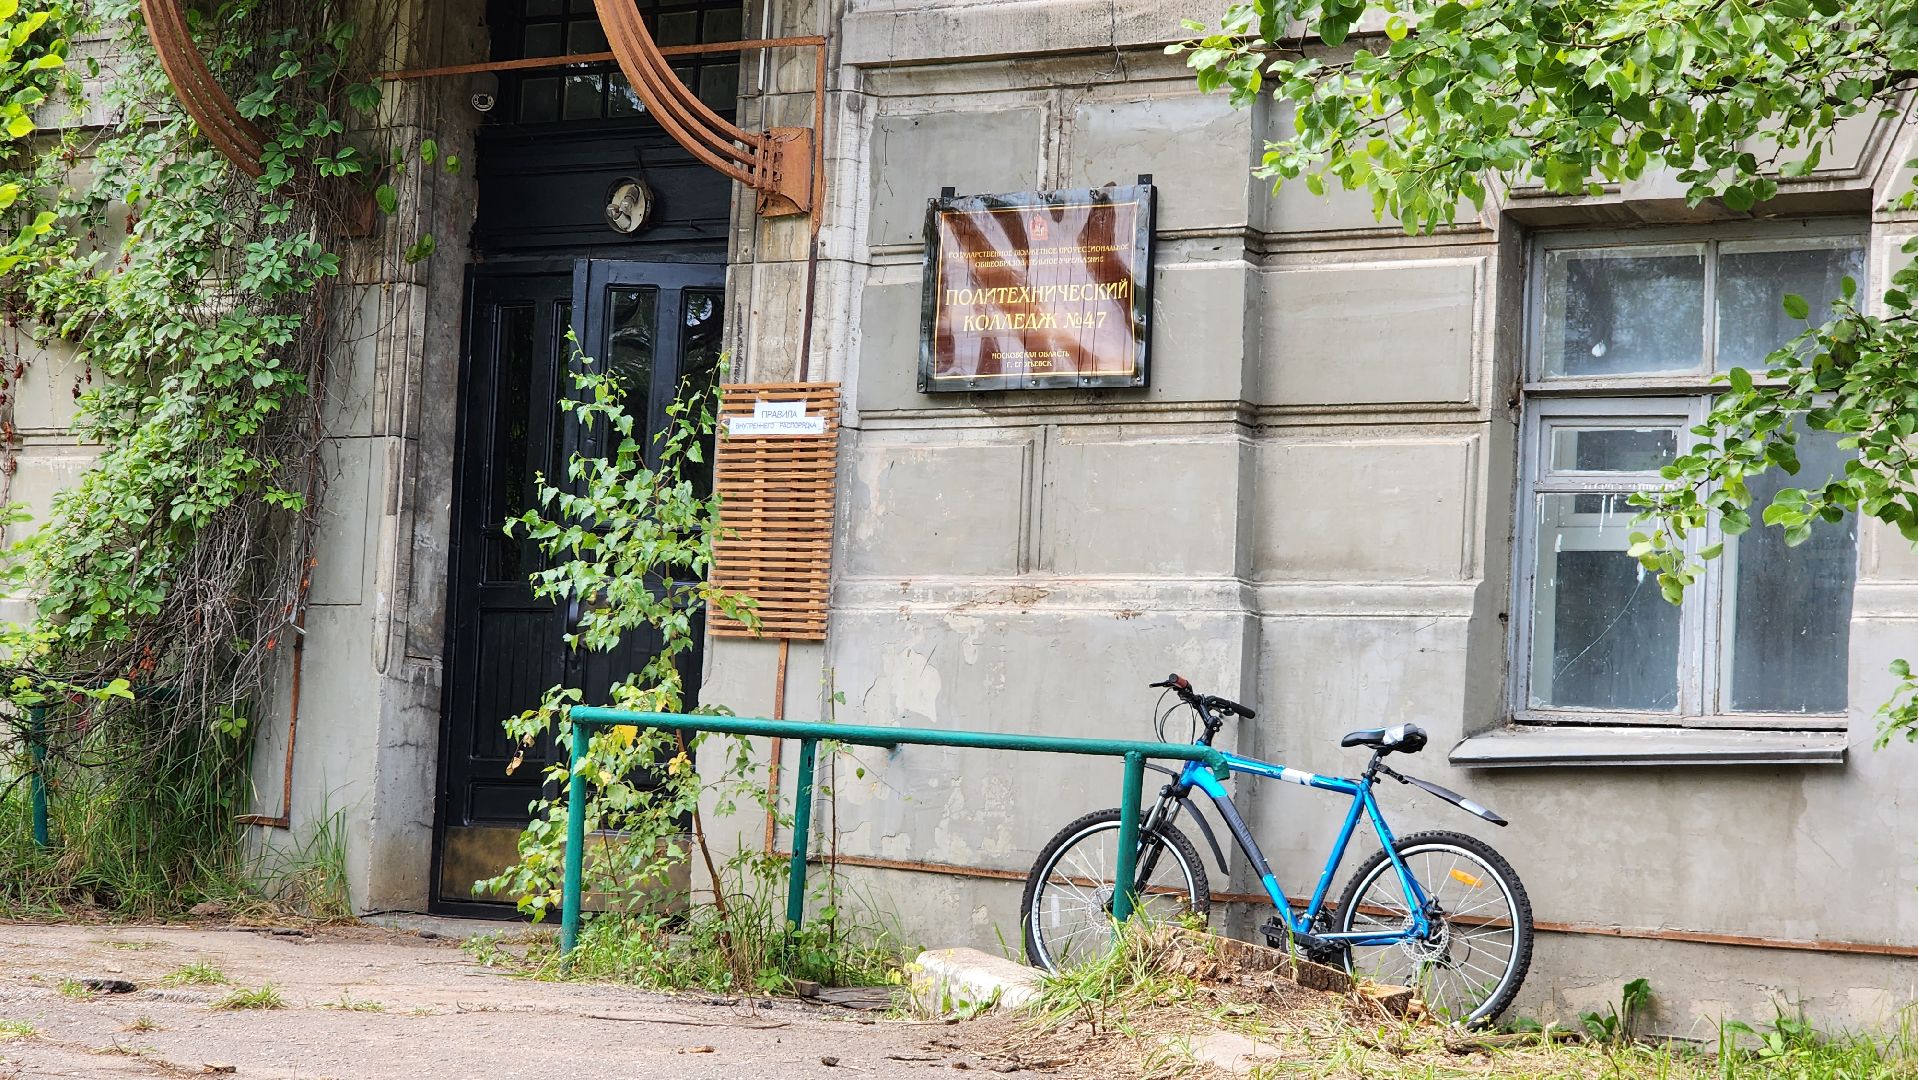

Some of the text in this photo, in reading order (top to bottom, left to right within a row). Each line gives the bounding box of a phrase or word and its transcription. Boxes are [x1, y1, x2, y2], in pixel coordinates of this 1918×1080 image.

[948, 249, 1013, 259] ГОСУДАРСТВЕННОЕ
[974, 256, 1058, 268] ОБЩЕОБРАЗОВАЕЛЬНОЕ
[945, 278, 1128, 306] ПОЛИТЕХНИЧЕСКИЙ
[963, 311, 1107, 332] КОЛЛЕДЖ №47
[991, 350, 1070, 360] МОСКОВСКАЯ ОБЛАСТЬ
[1014, 360, 1052, 368] ЕГОРЬЕВСК
[761, 410, 798, 419] ПРАВИЛА
[735, 421, 817, 430] ВНУТРЕННЕГО РАСПОРЯДКА
